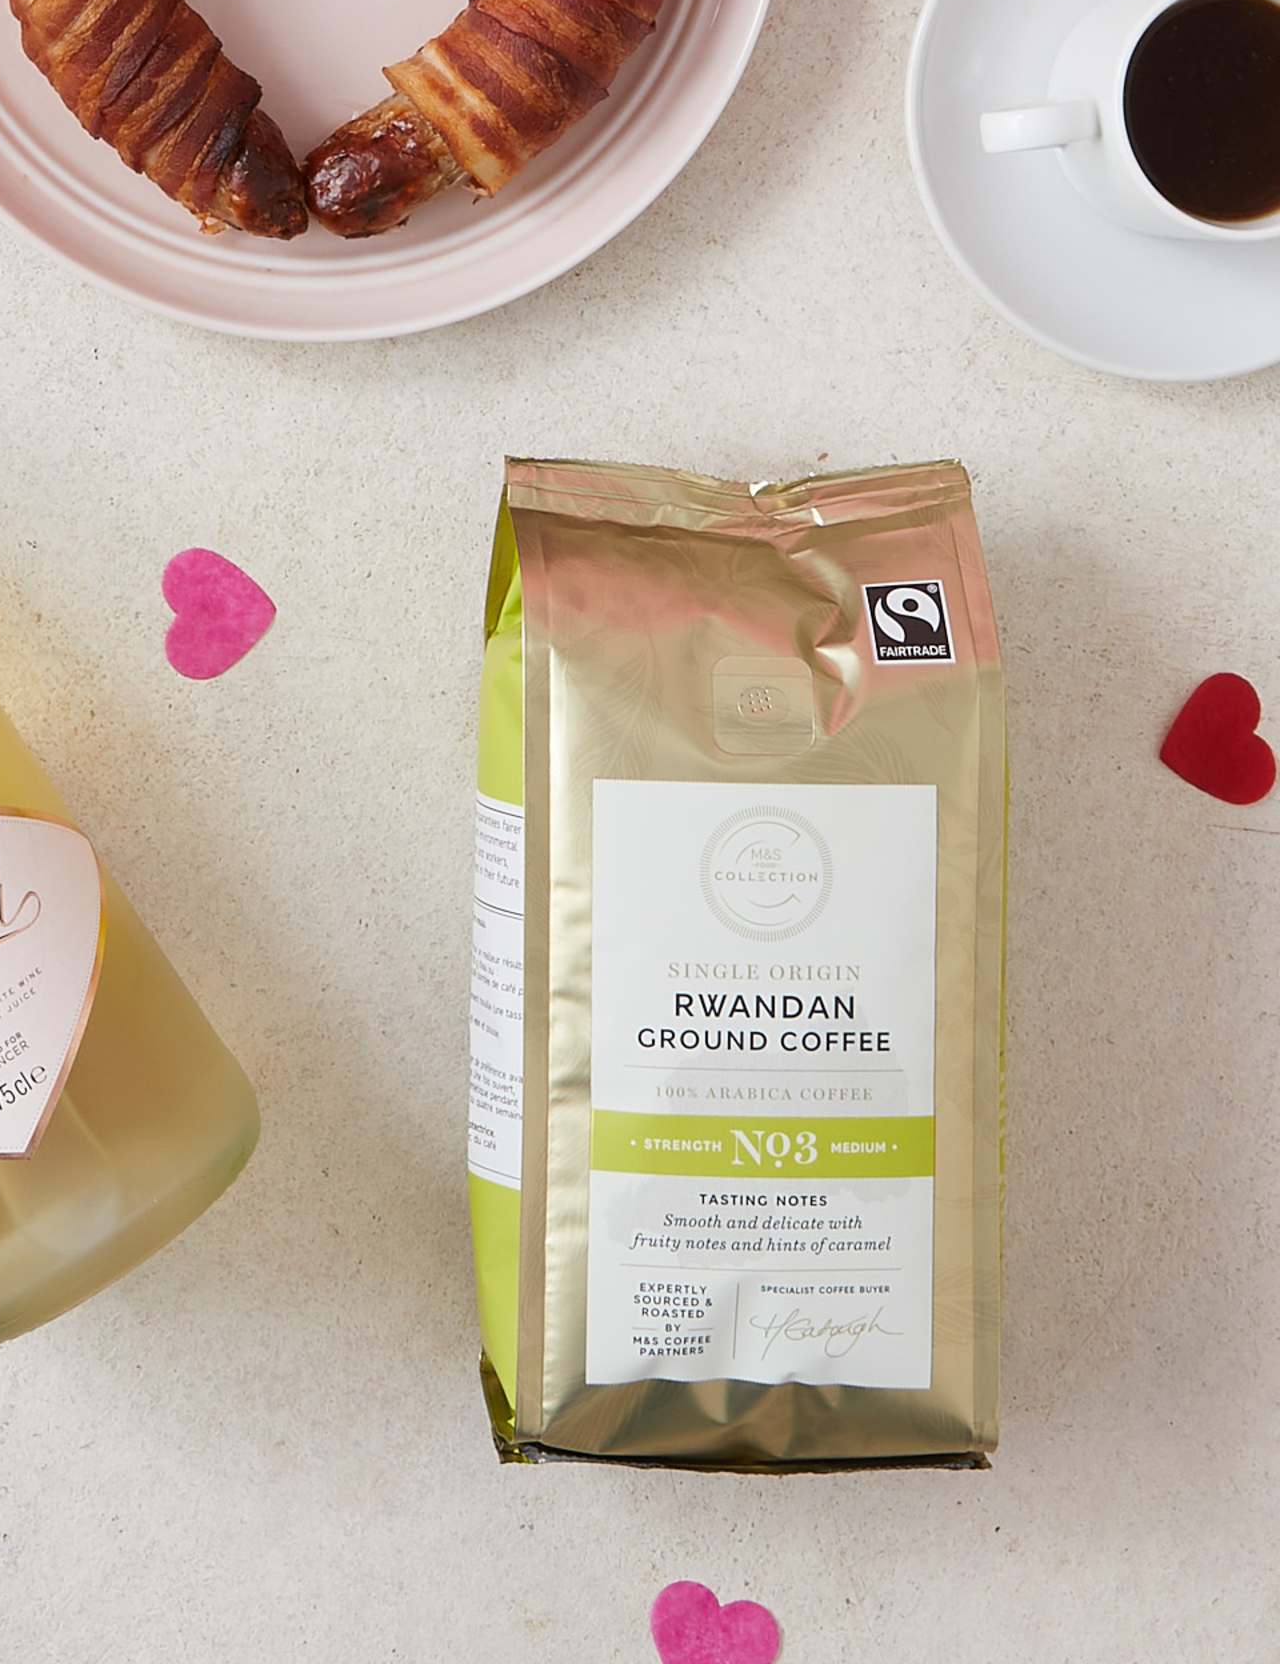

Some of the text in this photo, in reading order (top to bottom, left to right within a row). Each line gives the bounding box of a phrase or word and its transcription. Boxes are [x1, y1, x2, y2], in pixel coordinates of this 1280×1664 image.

[879, 644, 948, 657] FAIRTRADE
[751, 847, 782, 861] M&S
[714, 871, 818, 882] COLLECTION
[19, 966, 43, 988] WINE
[667, 962, 861, 982] SINGLE ORIGIN
[7, 987, 38, 1014] JUICE
[674, 992, 856, 1019] RWANDAN
[4, 1031, 24, 1048] FOR
[637, 1028, 891, 1052] GROUND COFFEE
[656, 1085, 873, 1101] 100% ARABICA COFFEE
[643, 1138, 722, 1152] STRENGTH
[830, 1141, 887, 1154] MEDIUM
[699, 1193, 828, 1207] TASTING NOTES
[663, 1212, 863, 1231] Smooth and delicate with
[628, 1232, 892, 1255] fruity notes and hints of caramel
[640, 1282, 708, 1295] EXPERTLY
[761, 1285, 890, 1294] SPECIALIST COFFEE BUYER
[633, 1294, 713, 1307] SOURCED &
[641, 1307, 705, 1319] ROASTED
[665, 1323, 681, 1333] BY
[632, 1335, 712, 1345] M&S COFFEE
[639, 1346, 704, 1356] PARTNERS
